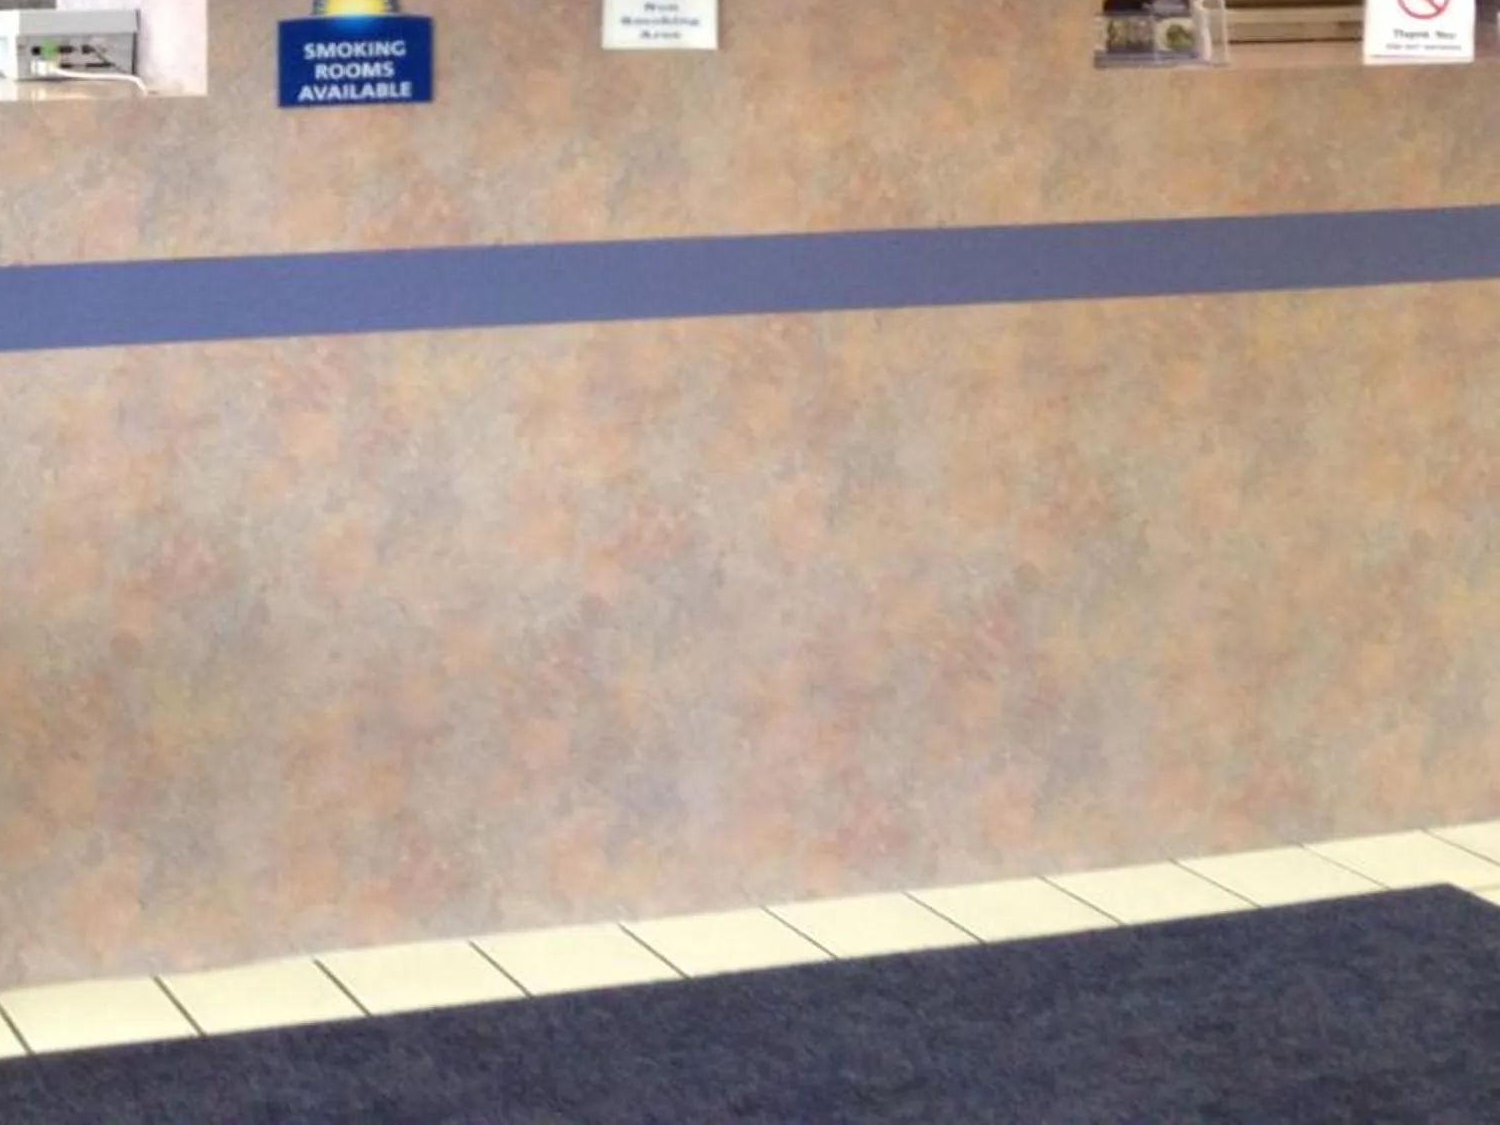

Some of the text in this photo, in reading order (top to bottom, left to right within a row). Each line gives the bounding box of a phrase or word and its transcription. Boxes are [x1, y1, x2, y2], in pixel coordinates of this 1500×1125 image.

[304, 40, 407, 59] SMOKING
[315, 61, 395, 79] ROOMS
[298, 81, 412, 101] AVAILABLE
